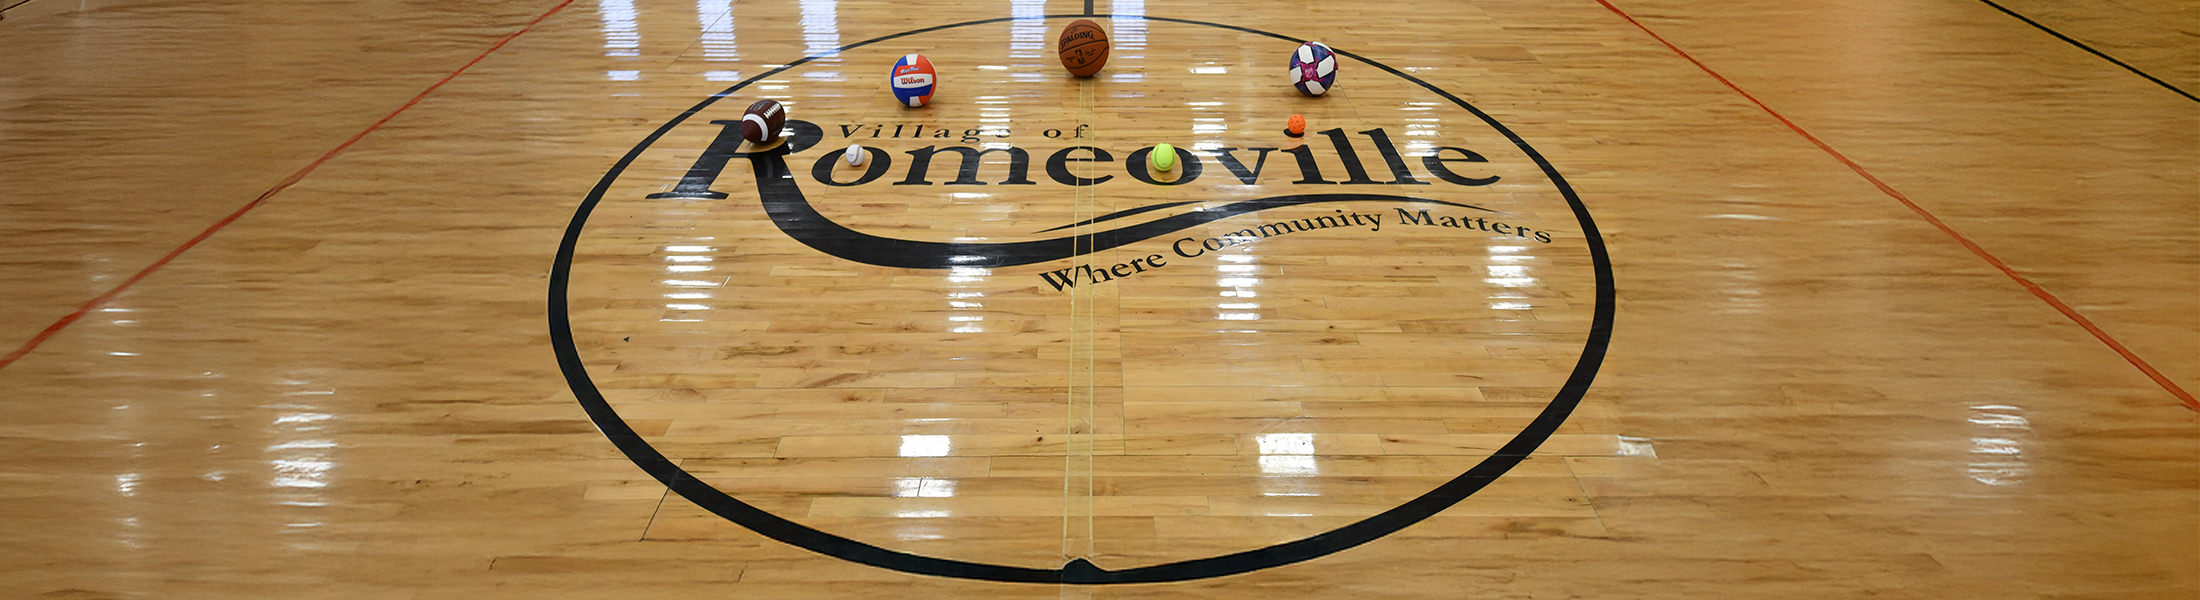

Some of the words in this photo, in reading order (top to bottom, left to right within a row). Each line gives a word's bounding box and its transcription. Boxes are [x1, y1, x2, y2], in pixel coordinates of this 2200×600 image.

[1060, 30, 1094, 49] SPALDING
[900, 77, 925, 85] Wilson
[838, 124, 1012, 143] Village
[1043, 123, 1090, 139] of
[645, 118, 1501, 200] Romeoville
[1038, 252, 1167, 293] Where
[1172, 209, 1383, 259] Community
[1393, 207, 1552, 244] Matters
